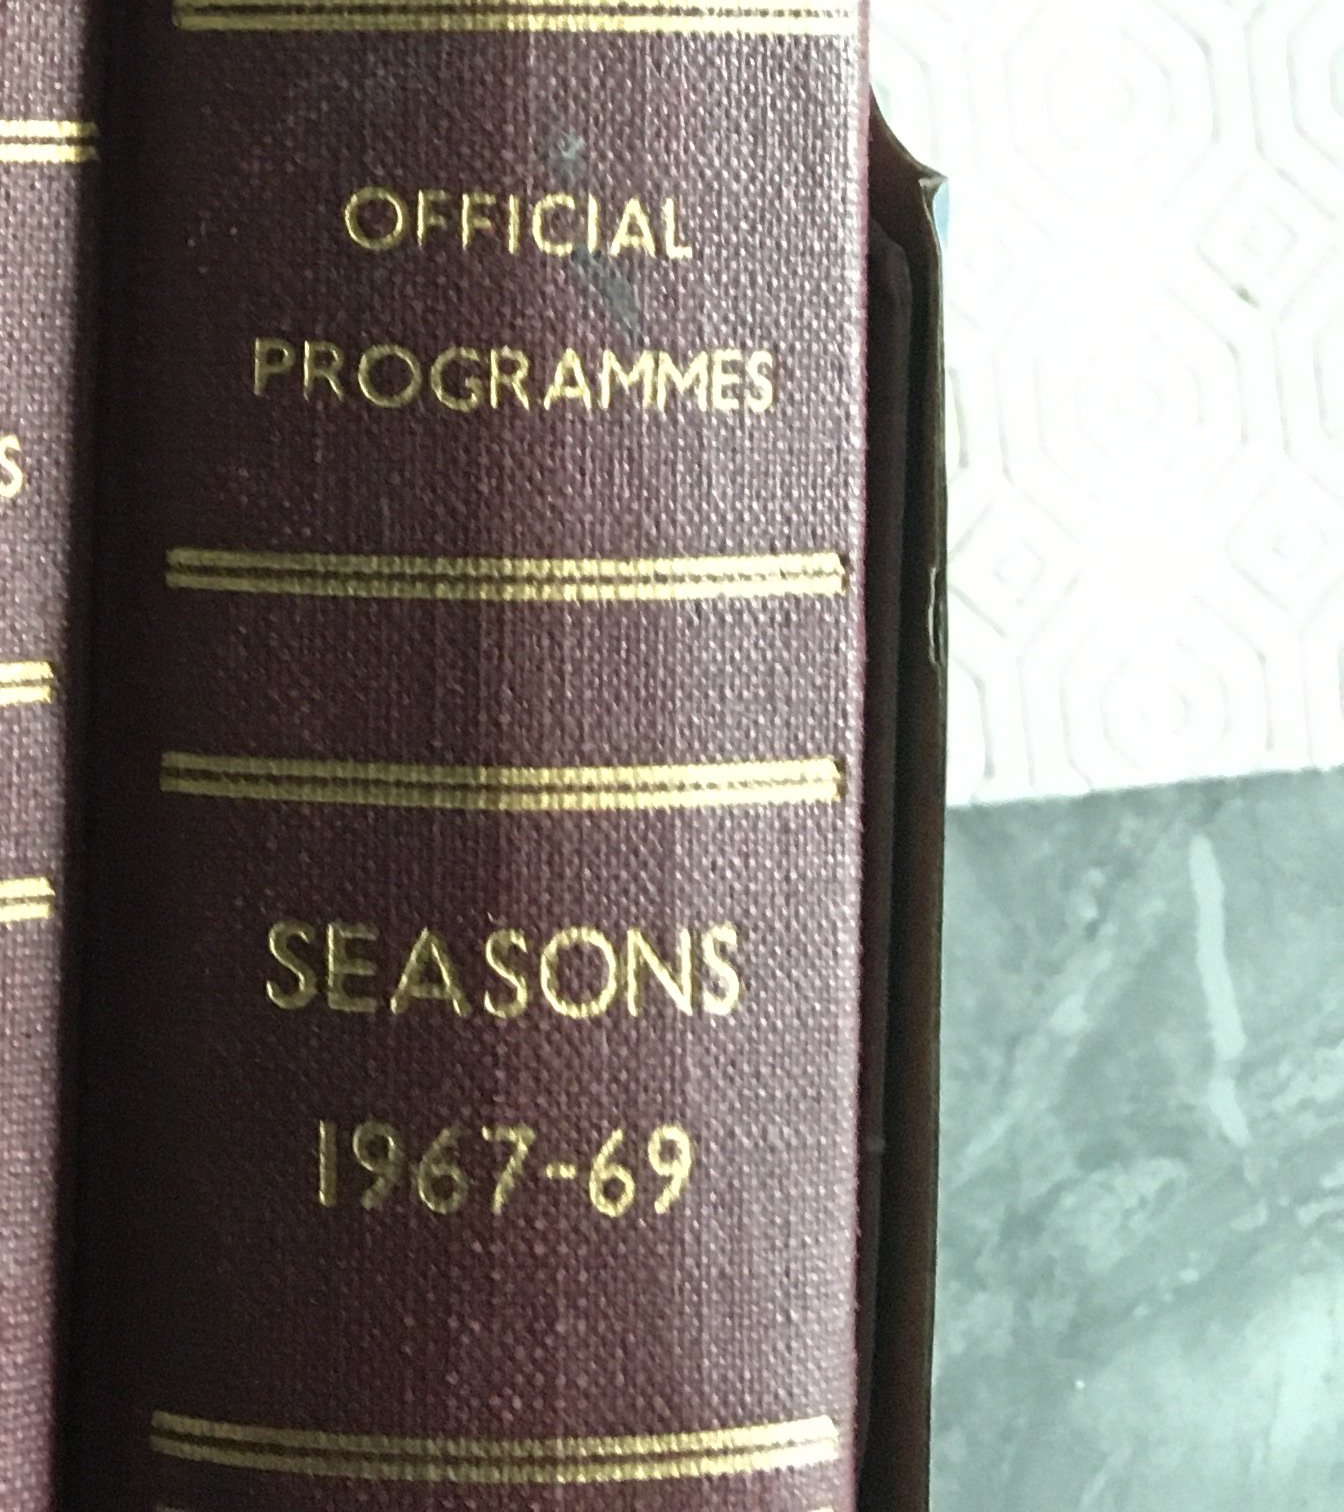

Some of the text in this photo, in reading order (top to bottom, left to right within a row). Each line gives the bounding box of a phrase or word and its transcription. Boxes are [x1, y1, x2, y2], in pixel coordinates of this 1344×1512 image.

[342, 186, 689, 259] OFFICIAL
[253, 339, 776, 413] PROGRAMMES
[266, 921, 745, 1020] SEASONS
[316, 1123, 696, 1218] 1967-69
